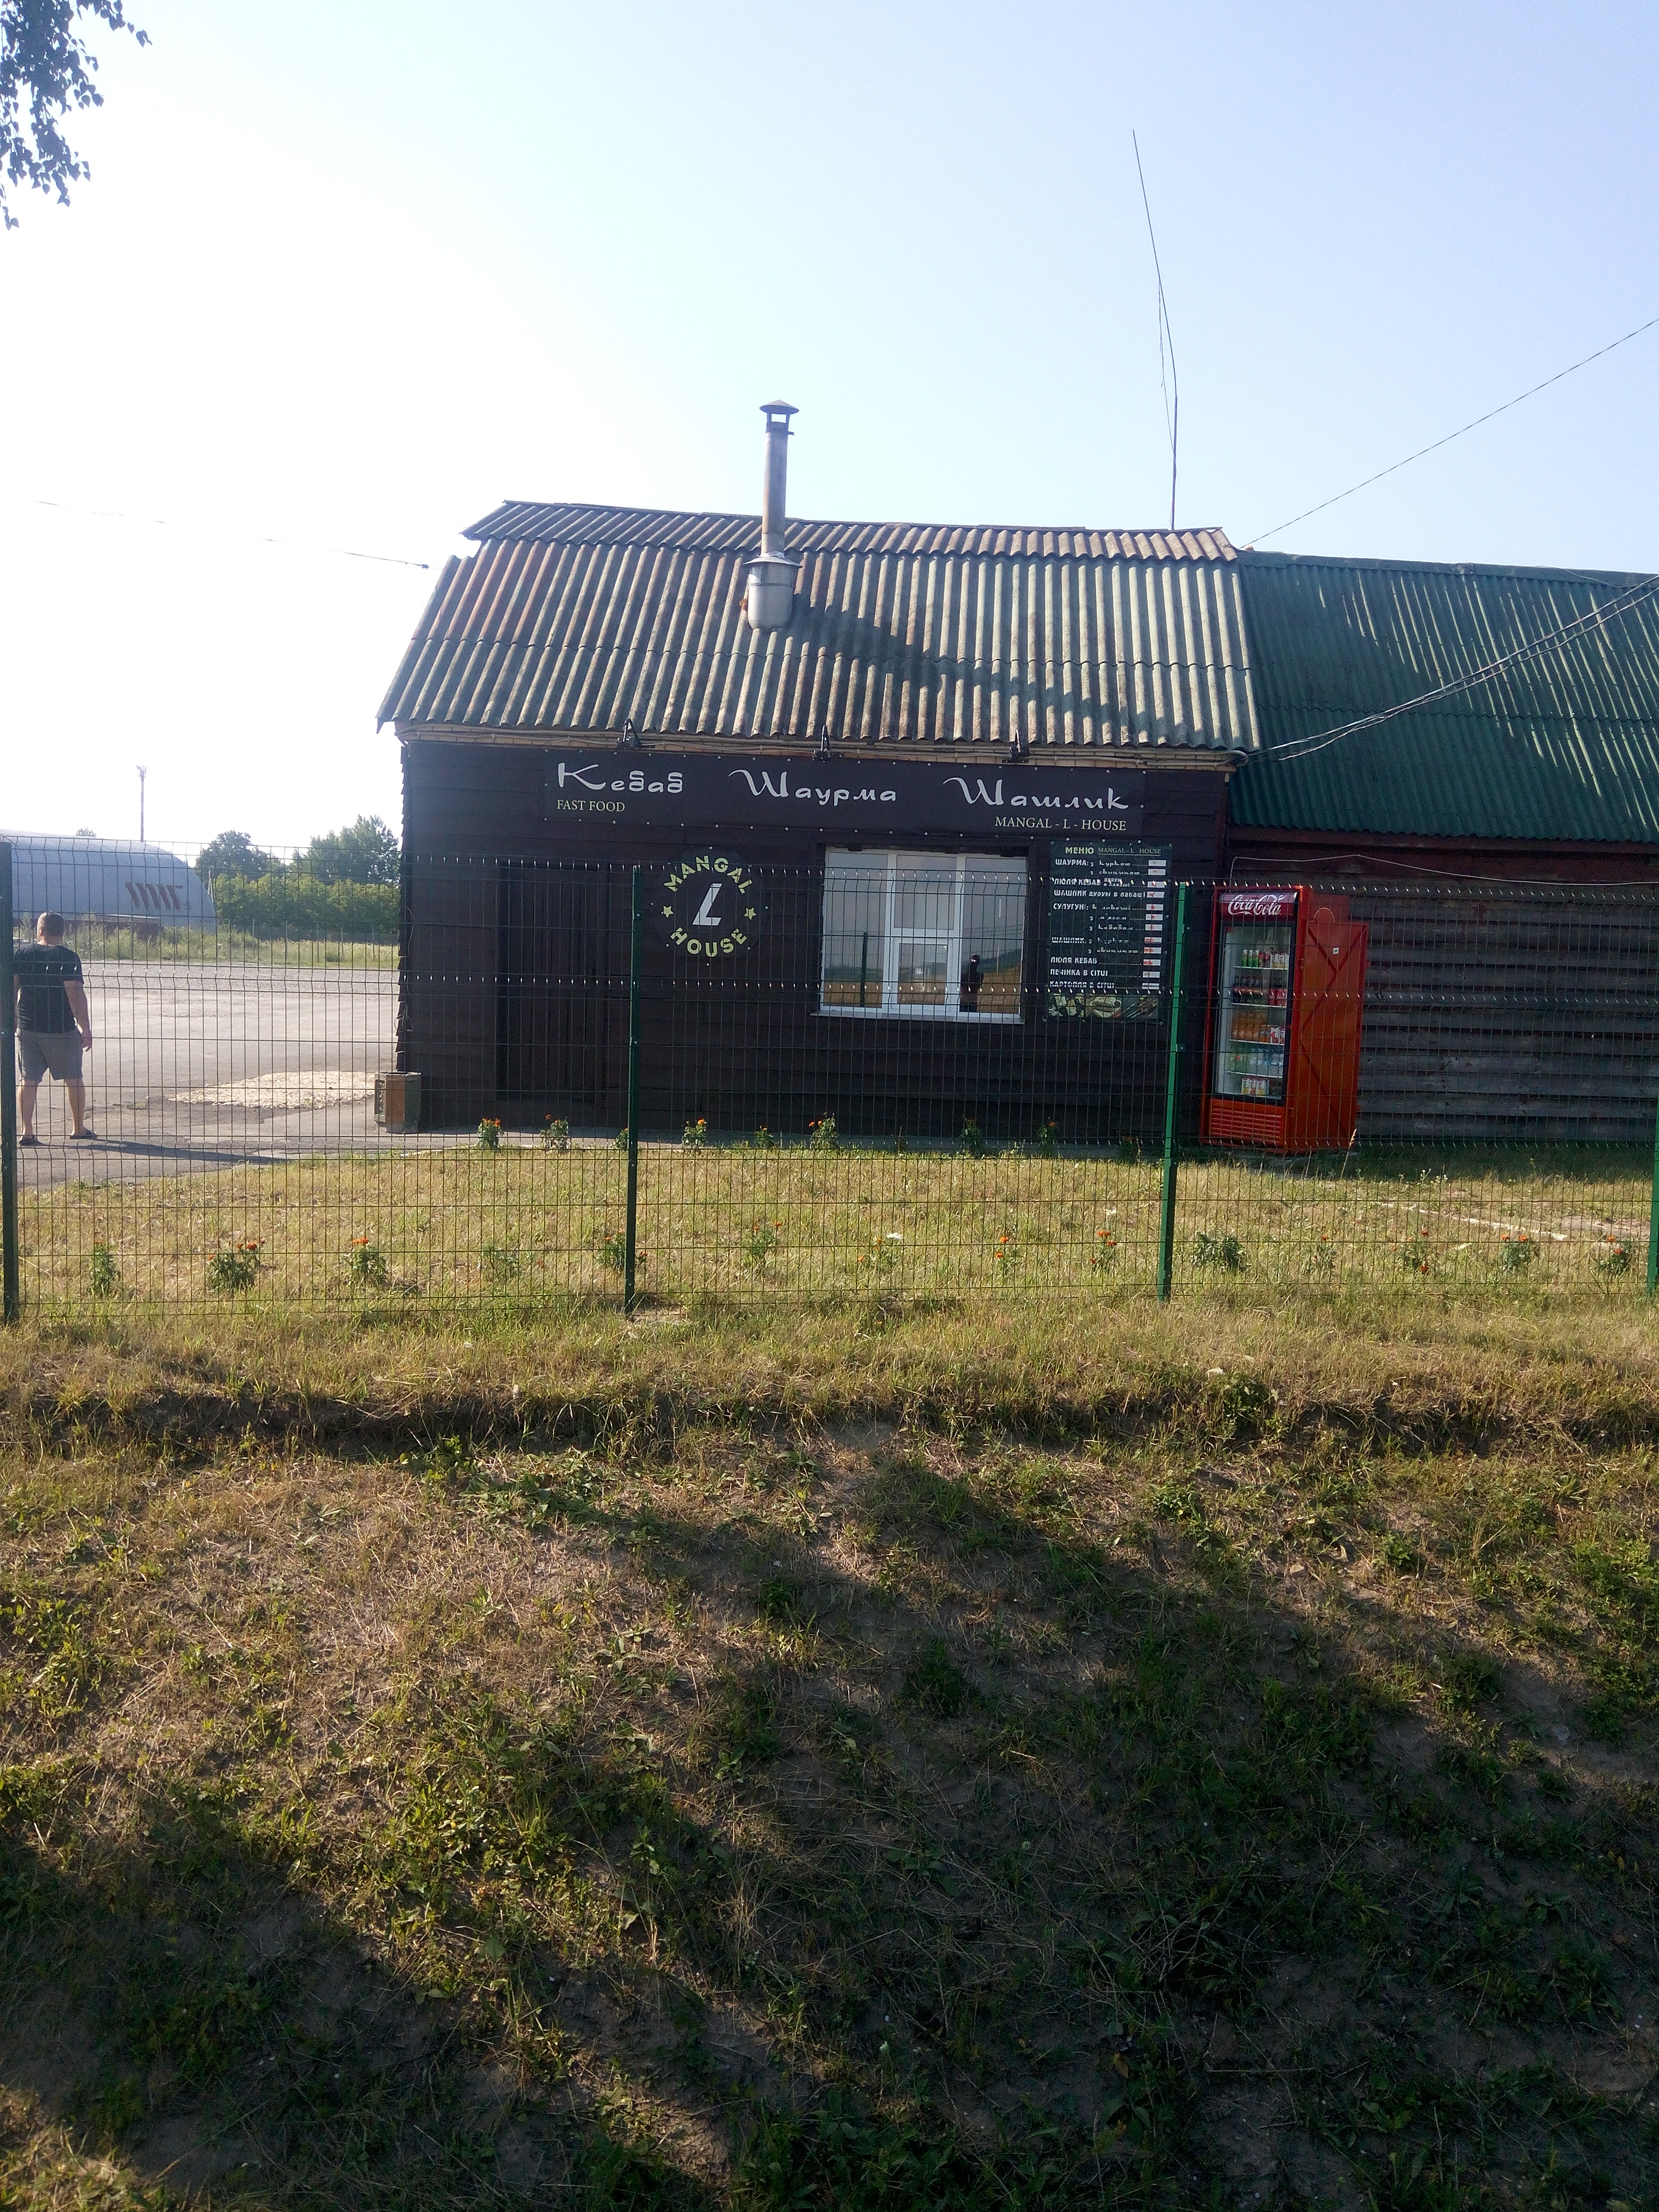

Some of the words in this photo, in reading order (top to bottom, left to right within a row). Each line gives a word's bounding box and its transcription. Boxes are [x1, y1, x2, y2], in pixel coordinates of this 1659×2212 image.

[558, 762, 683, 793] Кебаб
[728, 769, 896, 806] Шаурма
[943, 777, 1129, 809] Шашлик
[557, 799, 586, 810] FAST
[589, 801, 625, 812] FOOD
[995, 816, 1052, 829] MANGAL
[1063, 819, 1070, 829] L
[1082, 819, 1127, 831] HOUSE
[664, 855, 752, 894] MANGAL
[692, 883, 723, 926] L
[670, 927, 747, 957] HOUSE
